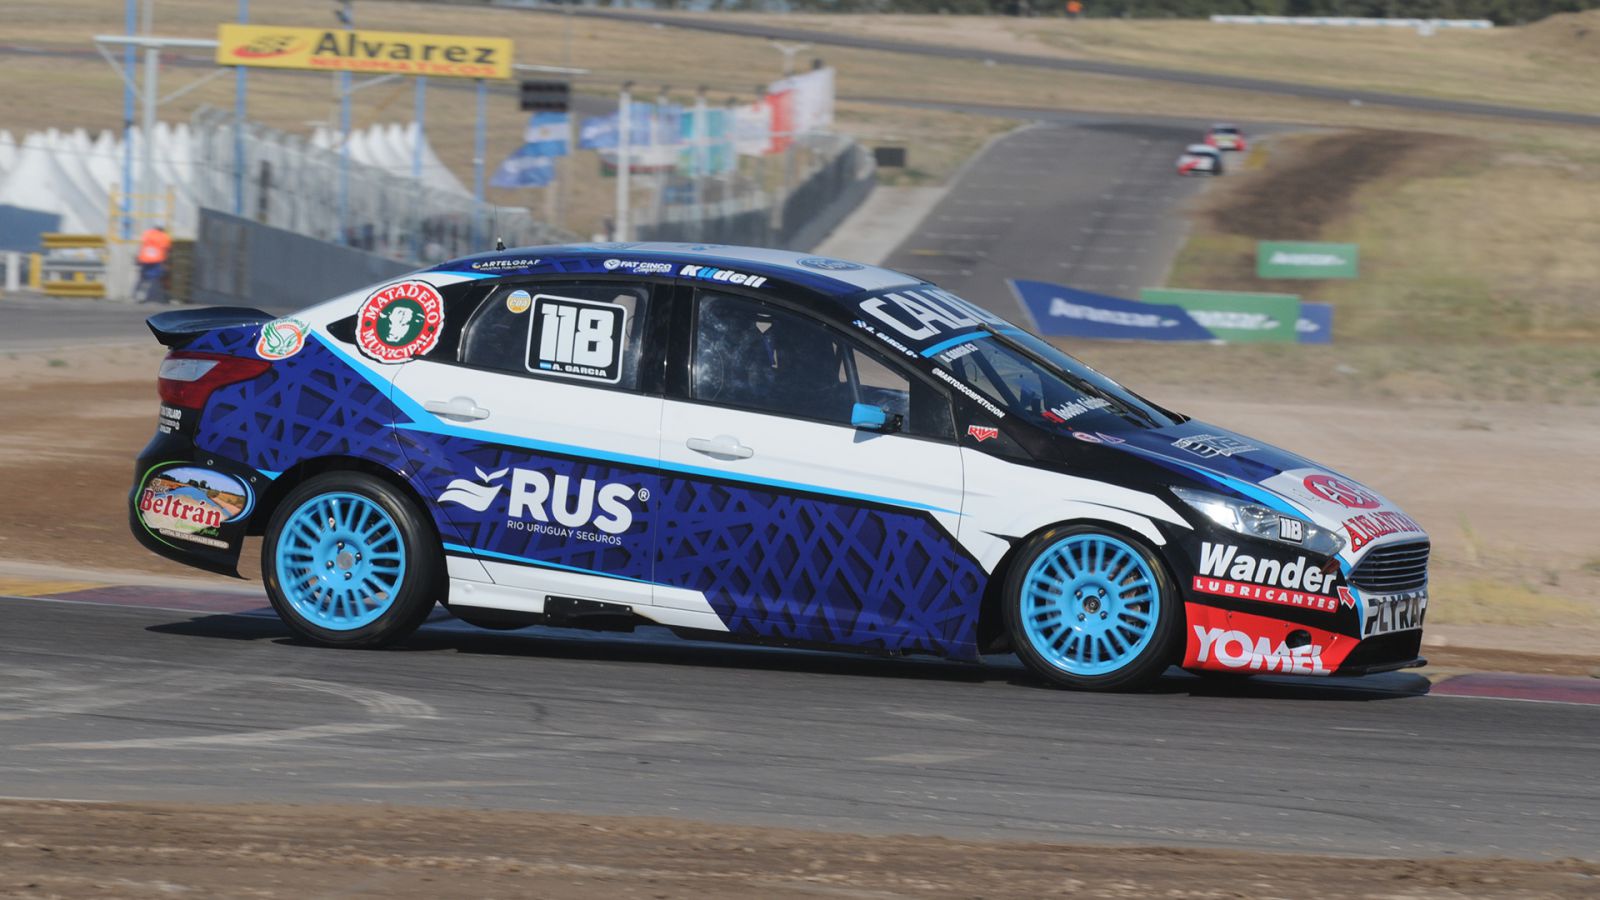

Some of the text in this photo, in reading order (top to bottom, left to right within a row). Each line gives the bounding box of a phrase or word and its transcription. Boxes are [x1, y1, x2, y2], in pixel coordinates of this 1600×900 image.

[314, 32, 496, 65] Alvarez
[620, 260, 672, 272] FAT CINCO
[366, 284, 439, 324] MATADERO
[363, 329, 433, 360] MUNICIPAL
[539, 303, 615, 368] 118
[551, 362, 607, 378] A. GARCIA
[968, 425, 999, 442] RIVA
[140, 488, 222, 528] Beltrán
[506, 519, 622, 546] RIO URUGUAY SEGUROS
[1280, 517, 1302, 541] 118
[1199, 541, 1338, 595] Wander
[1196, 579, 1336, 610] LUBRICANTES
[1193, 624, 1332, 676] YOMEL
